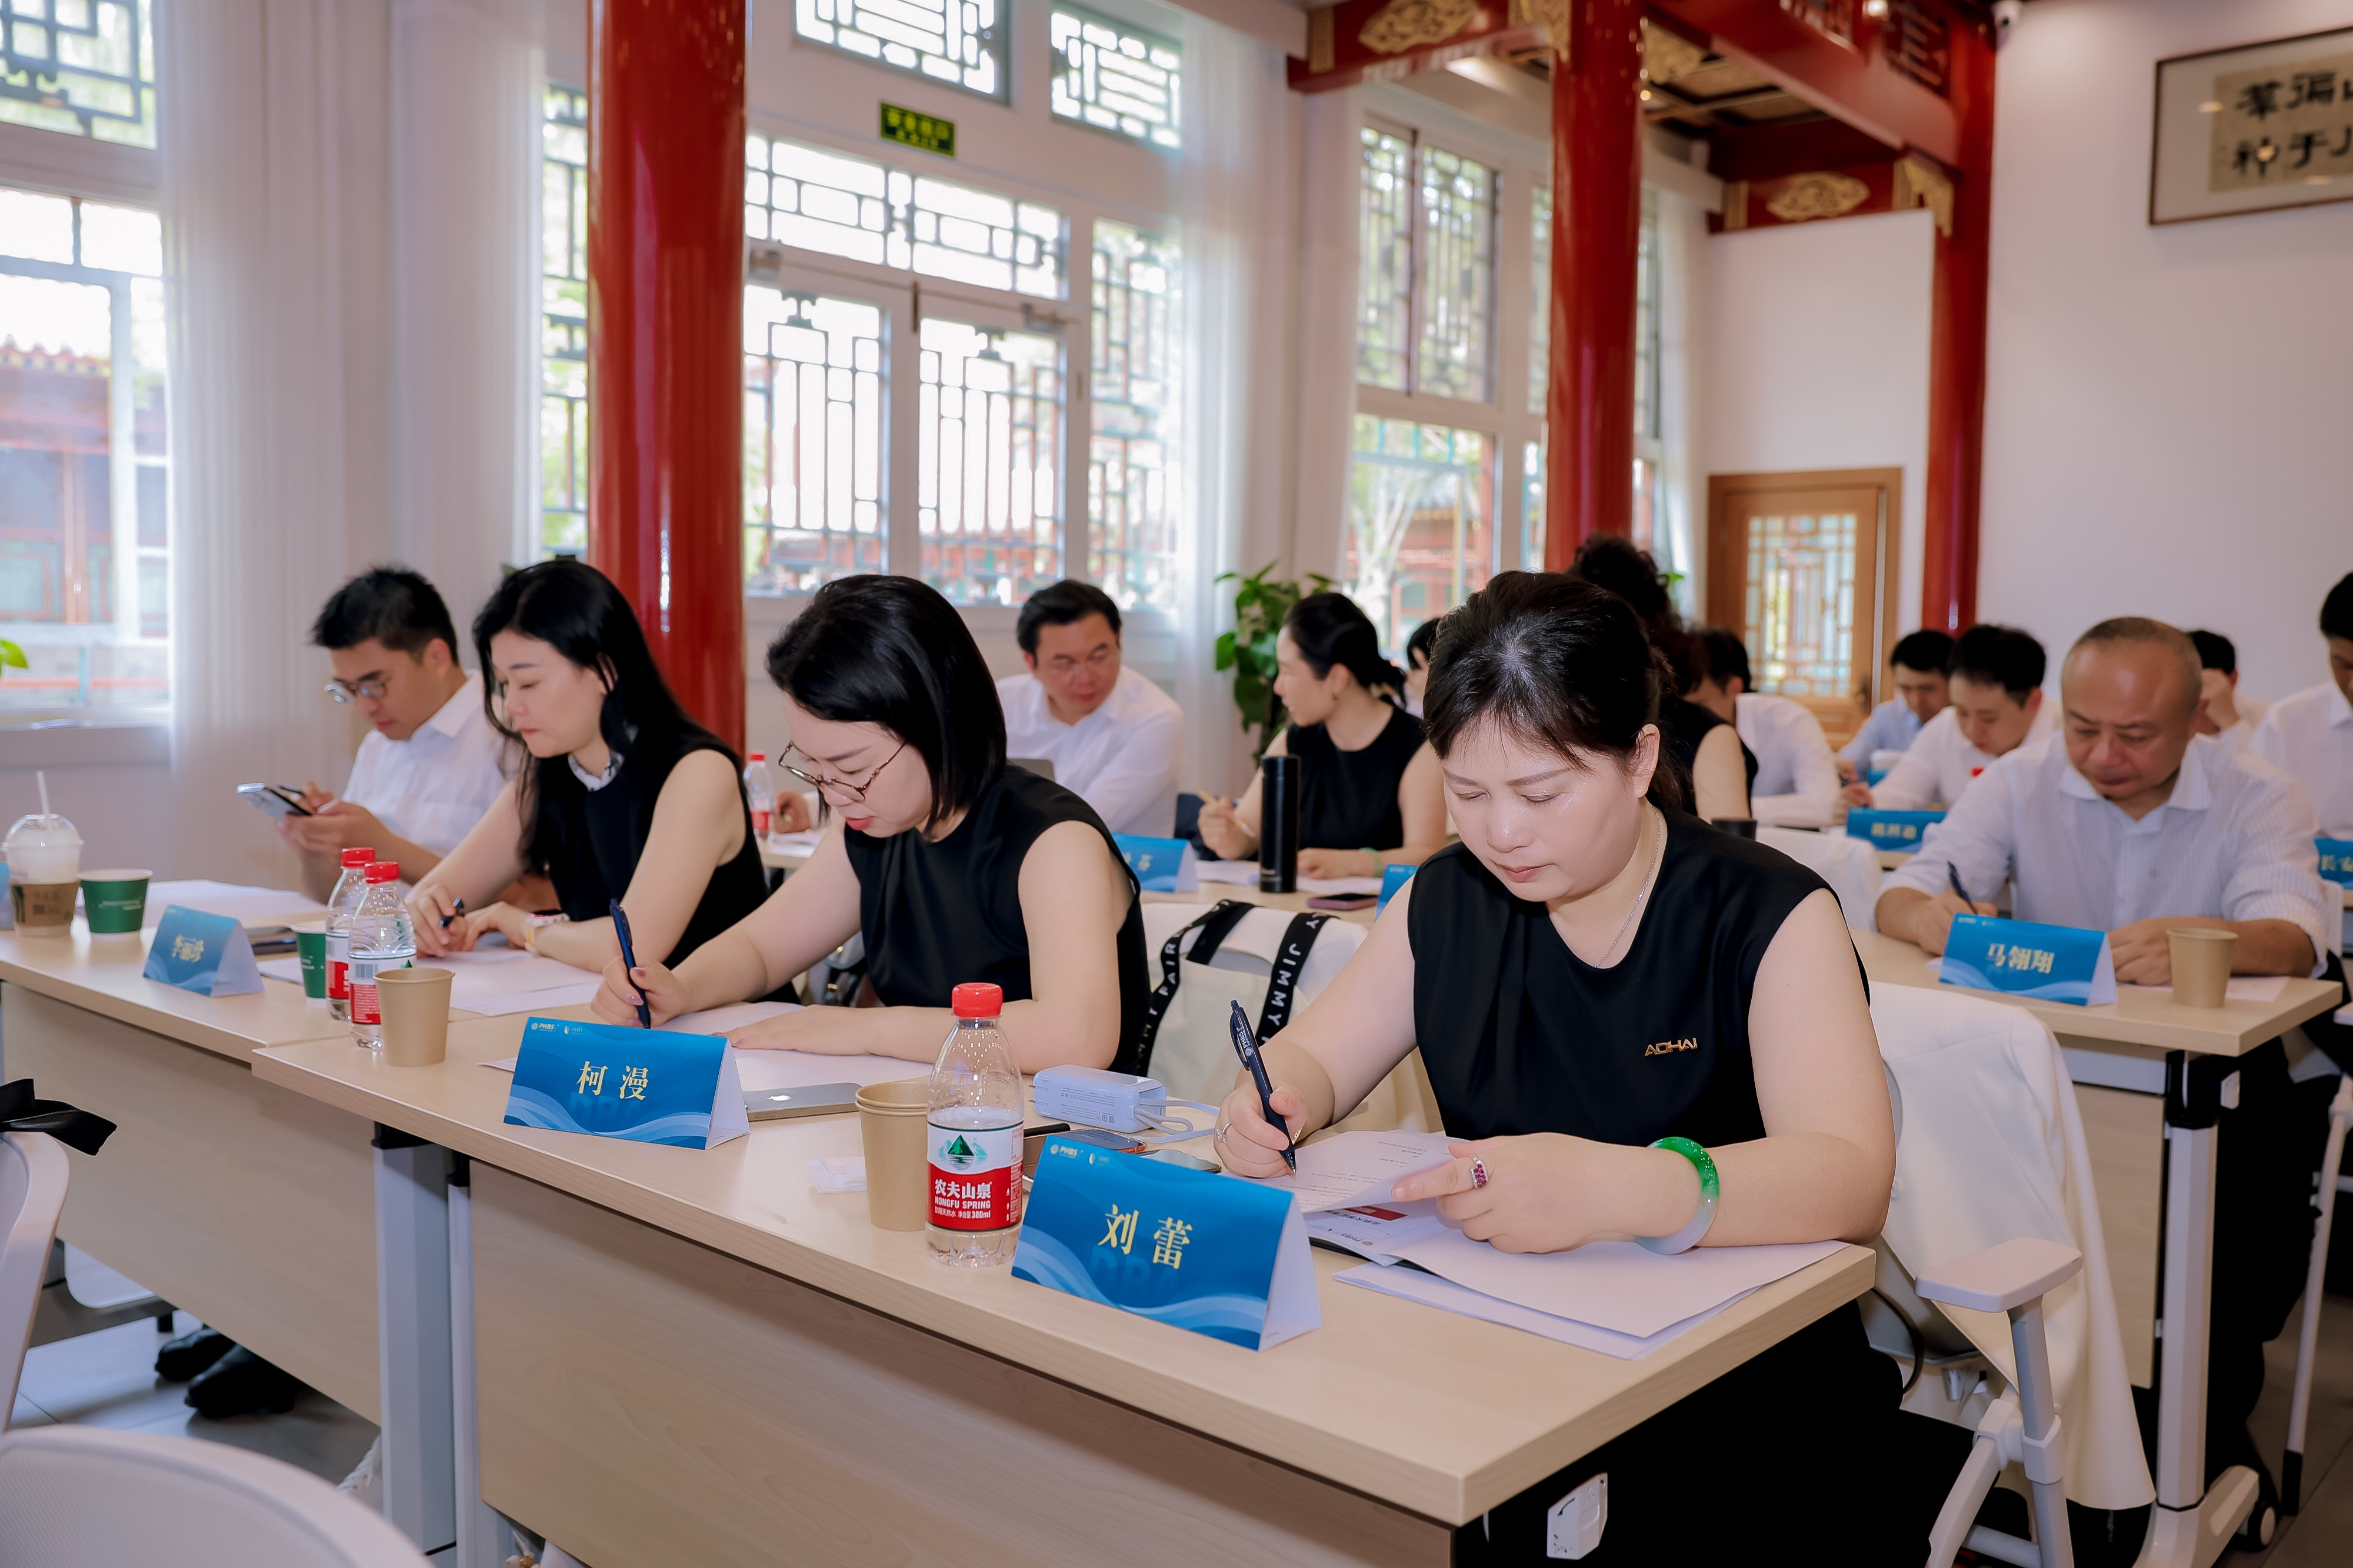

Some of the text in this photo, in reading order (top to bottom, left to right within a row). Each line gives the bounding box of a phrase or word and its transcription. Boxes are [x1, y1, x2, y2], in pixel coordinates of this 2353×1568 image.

[1267, 943, 1301, 1026] JIMMY
[1238, 1031, 1248, 1049] PHBS
[576, 1060, 649, 1100] 柯漫
[1059, 1146, 1078, 1156] PHBS
[935, 1179, 991, 1199] 农夫山泉
[935, 1196, 991, 1209] NONGFU SPRING
[1098, 1203, 1193, 1270] 刘蕾
